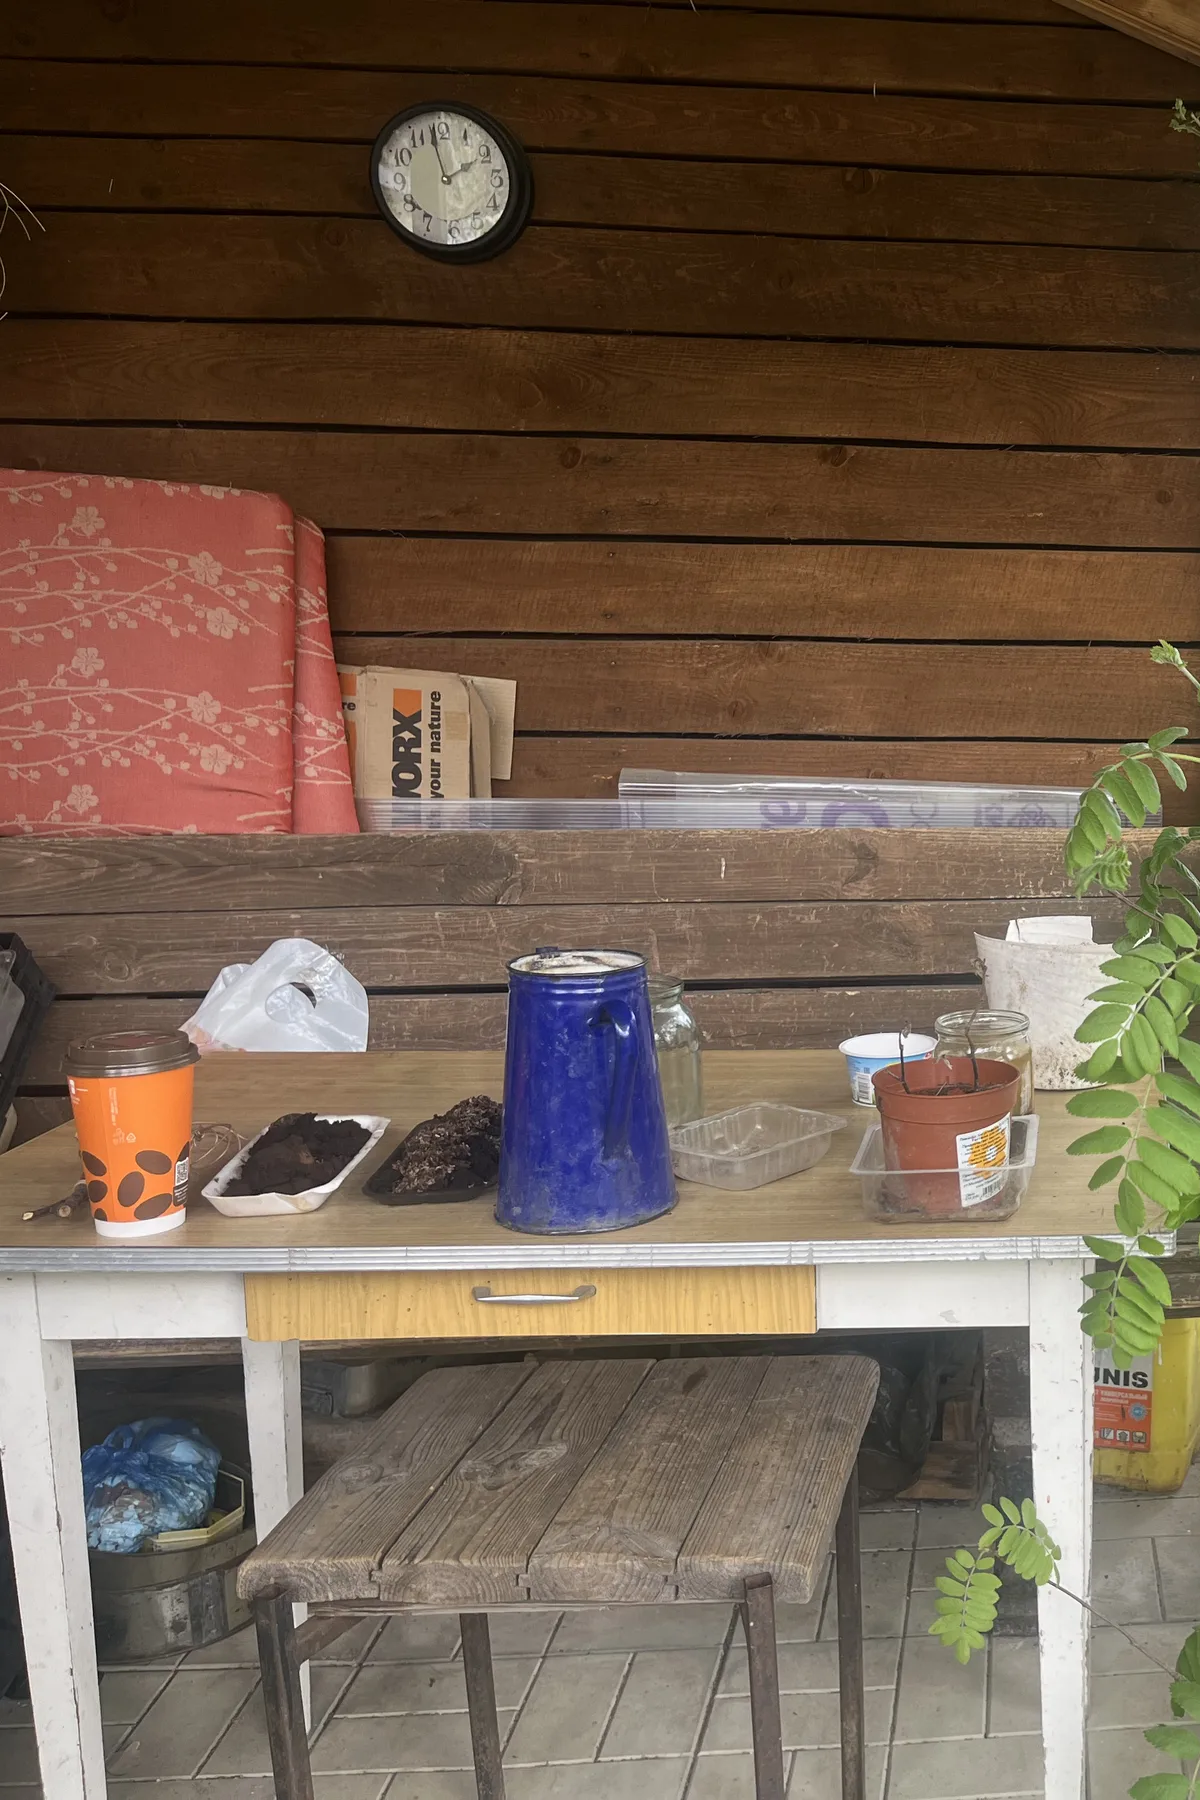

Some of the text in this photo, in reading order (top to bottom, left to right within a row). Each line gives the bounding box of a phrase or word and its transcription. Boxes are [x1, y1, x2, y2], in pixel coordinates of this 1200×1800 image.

[410, 129, 425, 148] 11
[462, 128, 470, 146] 1
[394, 147, 412, 167] 10
[478, 144, 492, 164] 2
[393, 172, 406, 192] 9
[490, 169, 503, 188] 3
[403, 193, 417, 213] 8
[486, 192, 500, 211] 4
[422, 214, 433, 232] 7
[448, 220, 461, 238] 6
[471, 212, 484, 230] 5
[342, 701, 356, 711] re
[428, 691, 441, 753] nature
[430, 759, 444, 798] your
